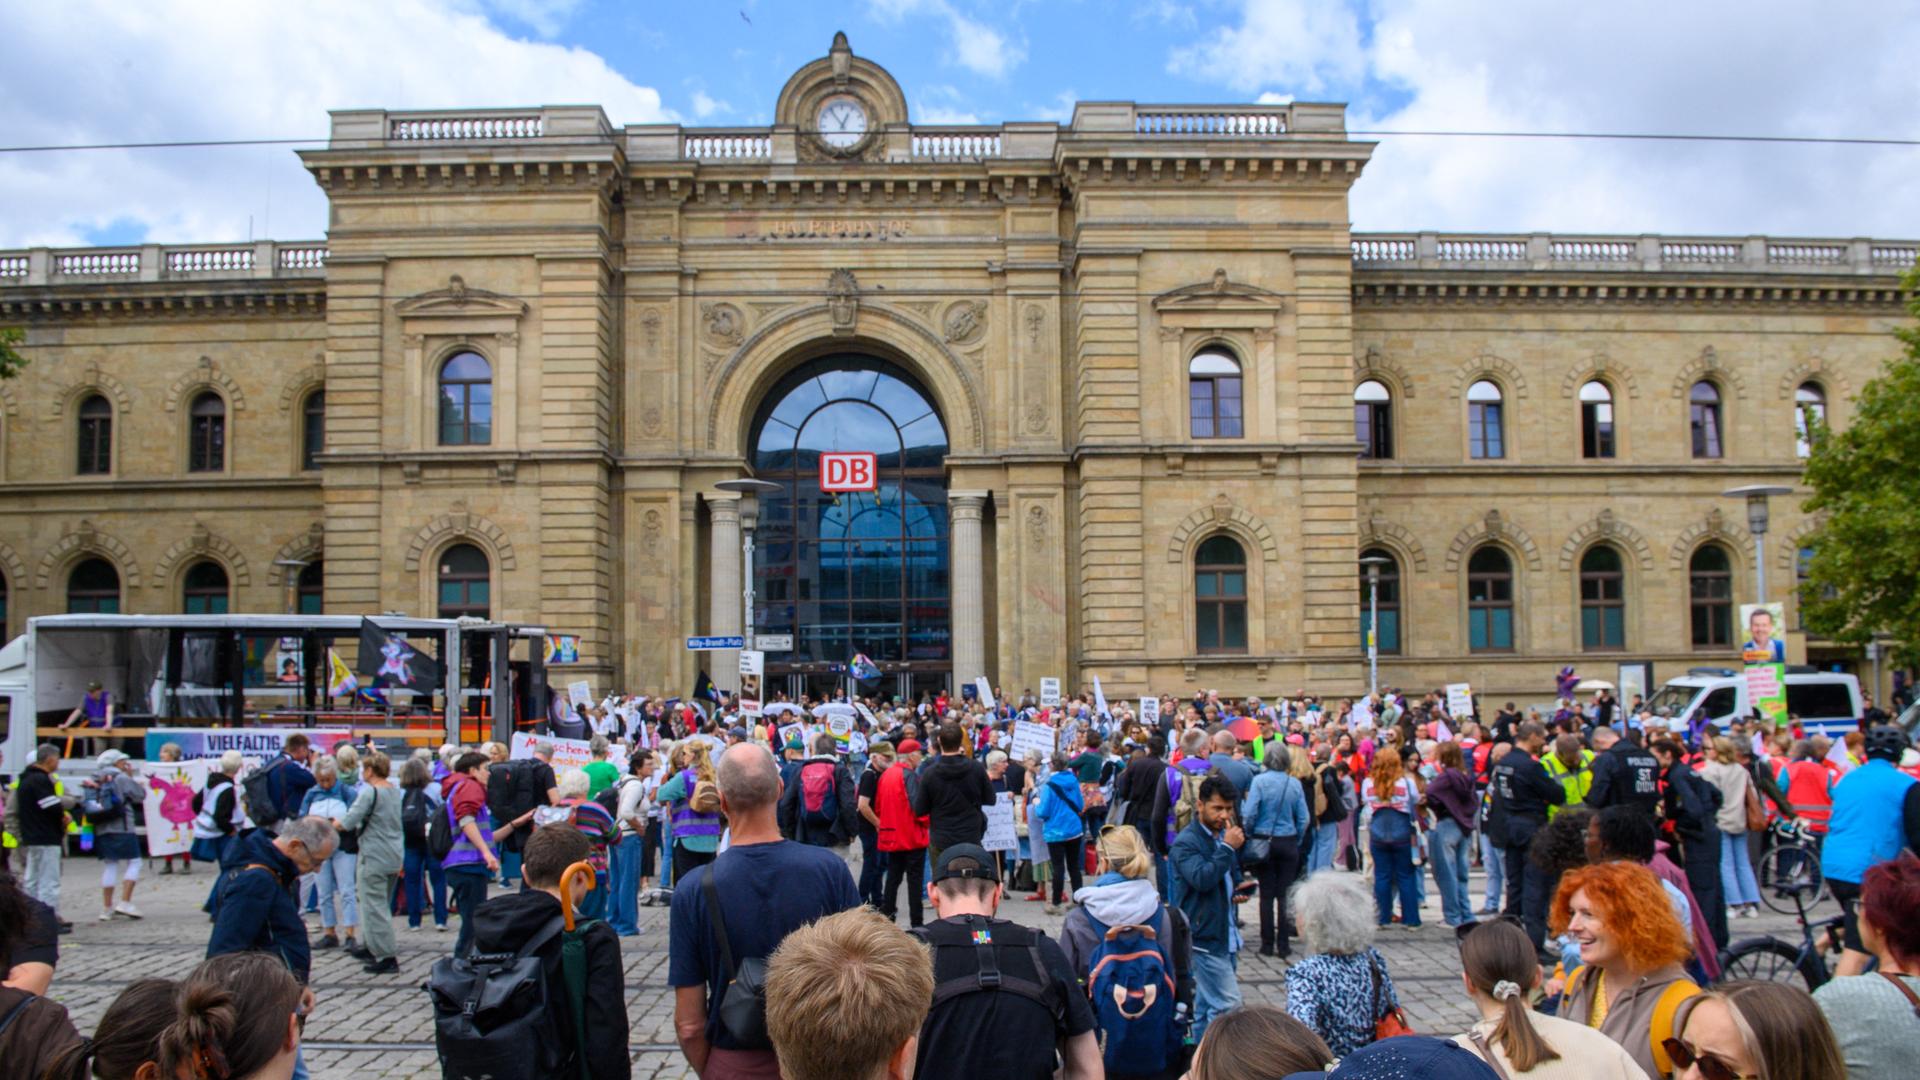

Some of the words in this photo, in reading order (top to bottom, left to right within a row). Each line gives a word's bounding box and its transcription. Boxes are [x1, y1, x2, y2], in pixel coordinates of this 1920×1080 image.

[828, 459, 869, 484] DB
[688, 637, 743, 648] Willy-Brandt-Platz
[207, 733, 281, 751] VIELFÄLTIG
[1626, 756, 1658, 767] POLIZEI
[1638, 768, 1652, 781] ST
